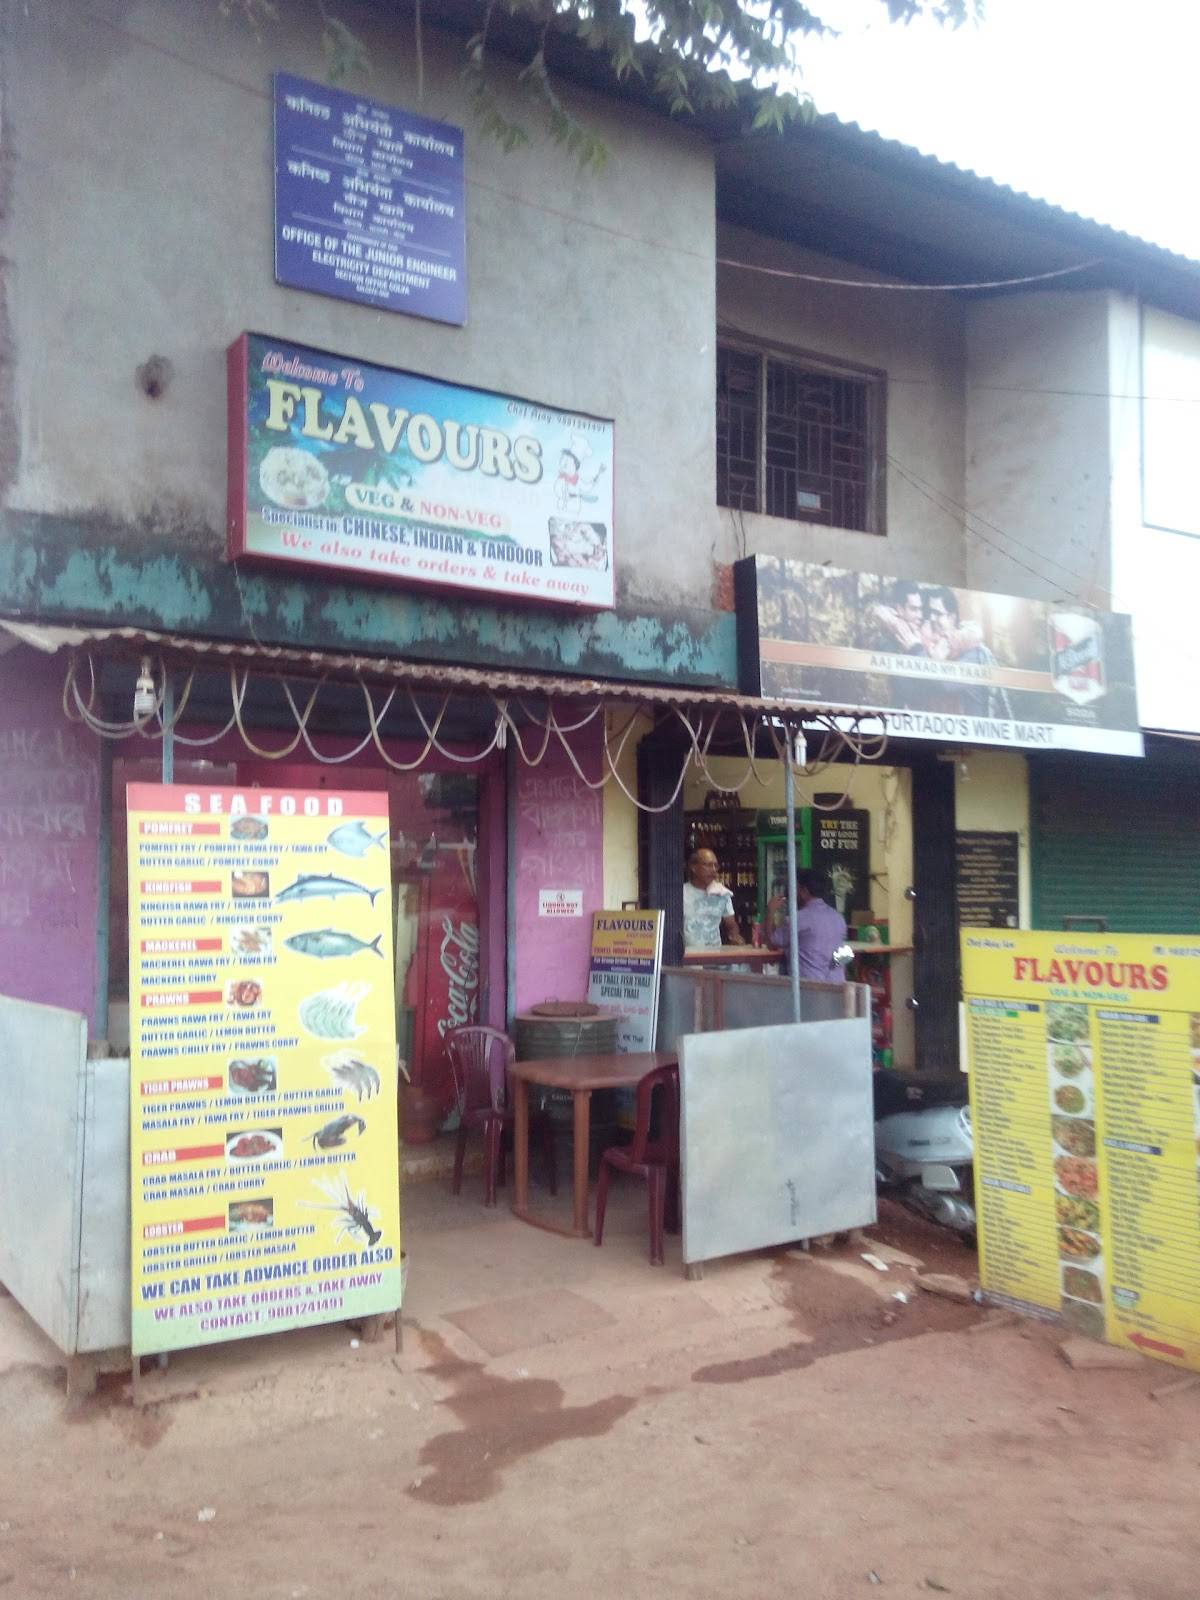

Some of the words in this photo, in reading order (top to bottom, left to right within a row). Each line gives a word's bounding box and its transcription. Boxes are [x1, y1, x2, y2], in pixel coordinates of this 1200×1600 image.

[282, 225, 321, 248] OFFICE
[324, 235, 338, 251] OF
[342, 240, 362, 258] THE
[365, 247, 403, 268] JUNIOR
[406, 257, 456, 281] ENGINEER
[312, 250, 369, 274] ELECTRICITY
[372, 264, 430, 289] DEPARTMENT
[263, 352, 338, 386] Welcome
[341, 368, 364, 392] To
[265, 378, 544, 484] FLAVOURS
[355, 488, 394, 509] VEG
[400, 497, 415, 513] &
[420, 501, 501, 528] NON-VEG
[261, 505, 323, 530] Specialist
[326, 518, 337, 533] in
[343, 516, 410, 546] CHINESE,
[414, 528, 463, 554] INDIAN
[467, 542, 477, 556] &
[481, 540, 543, 567] TANDOOR
[282, 531, 312, 548] We
[320, 540, 361, 557] also
[370, 548, 410, 566] take
[417, 557, 477, 578] orders
[482, 565, 496, 581] &
[504, 570, 540, 587] take
[544, 580, 589, 597] away
[971, 719, 1010, 741] WINE
[1014, 723, 1054, 743] MART
[144, 822, 192, 835] POMFRET
[820, 819, 837, 829] TRY
[840, 820, 858, 830] THE
[820, 830, 837, 838] NEW
[139, 843, 178, 853] POMFRET
[180, 843, 195, 853] FRY
[204, 844, 240, 853] POMFRET
[243, 844, 267, 853] RAWA
[269, 844, 283, 854] FRY
[292, 845, 313, 854] TAWA
[314, 845, 328, 854] FRY
[820, 838, 837, 849] OF
[838, 839, 858, 849] FUN
[139, 857, 173, 866] BUTTER
[174, 857, 204, 867] GARLIC
[213, 857, 249, 866] POMFRET
[252, 857, 279, 867] CURRY
[145, 881, 192, 893] KINGFISH
[141, 902, 181, 911] KINGFISH
[183, 902, 208, 911] RAWA
[211, 901, 225, 910] FRY
[234, 901, 255, 910] TAWA
[258, 901, 272, 910] FRY
[141, 916, 173, 925] BUTTER
[176, 916, 205, 925] GARLIC
[216, 915, 254, 924] KINGFISH
[256, 915, 283, 924] CURRY
[597, 919, 654, 931] FLAVOURS
[188, 958, 213, 968] RAWA
[216, 957, 230, 967] FRY
[239, 956, 261, 966] TAWA
[263, 955, 277, 965] FRY
[1013, 956, 1168, 991] FLAVOURS
[145, 992, 189, 1007] PRAWNS
[141, 1016, 179, 1027] PRAWNS
[181, 1014, 207, 1025] RAWA
[209, 1013, 224, 1023] FRY
[233, 1011, 255, 1021] TAWA
[257, 1009, 271, 1019] FRY
[141, 1031, 174, 1042] BUTTER
[176, 1029, 207, 1040] GARLIC
[215, 1027, 243, 1037] LEMON
[245, 1025, 276, 1035] BUTTER
[141, 1047, 179, 1058] PRAWNS
[181, 1044, 209, 1055] CHILLY
[211, 1043, 226, 1053] FRY
[234, 1040, 270, 1051] PRAWNS
[272, 1037, 299, 1048] CURRY
[144, 1080, 169, 1095] TIGER
[171, 1077, 209, 1092] PRAWNS
[142, 1104, 167, 1114] TIGER
[169, 1100, 206, 1112] PRAWNS
[215, 1097, 243, 1107] LEMON
[245, 1095, 275, 1105] BUTTER
[283, 1091, 313, 1101] BUTTER
[315, 1088, 342, 1097] GARLIC
[142, 1118, 177, 1130] MASALA
[180, 1116, 195, 1126] FRY
[204, 1113, 227, 1124] TAWA
[229, 1112, 244, 1122] FRY
[253, 1108, 275, 1118] TIGER
[277, 1105, 312, 1116] PRAWNS
[314, 1102, 344, 1112] GRILLED
[144, 1150, 176, 1164] CRAB
[142, 1175, 166, 1185] CRAB
[169, 1170, 204, 1182] MASALA
[206, 1169, 220, 1178] FRY
[229, 1165, 260, 1175] BUTTER
[263, 1161, 291, 1171] GARLIC
[299, 1156, 325, 1166] LEMON
[327, 1152, 356, 1163] BUTTER
[142, 1245, 181, 1257] LOBSTER
[183, 1240, 216, 1251] BUTTER
[218, 1235, 247, 1246] GARLIC
[256, 1230, 282, 1240] LEMON
[285, 1225, 315, 1235] BUTTER
[142, 1283, 165, 1299] WE
[170, 1277, 200, 1295] CAN
[205, 1272, 239, 1289] TAKE
[244, 1260, 308, 1283] ADVANCE
[312, 1254, 356, 1272] ORDER
[361, 1247, 393, 1265] ALSO
[154, 1307, 174, 1321] WE
[180, 1301, 213, 1317] ALSO
[218, 1295, 246, 1309] TAKE
[251, 1287, 301, 1303] ORDERS
[305, 1286, 313, 1295] &
[318, 1279, 345, 1293] TAKE
[349, 1272, 382, 1288] AWAY
[201, 1311, 259, 1330] CONTACT
